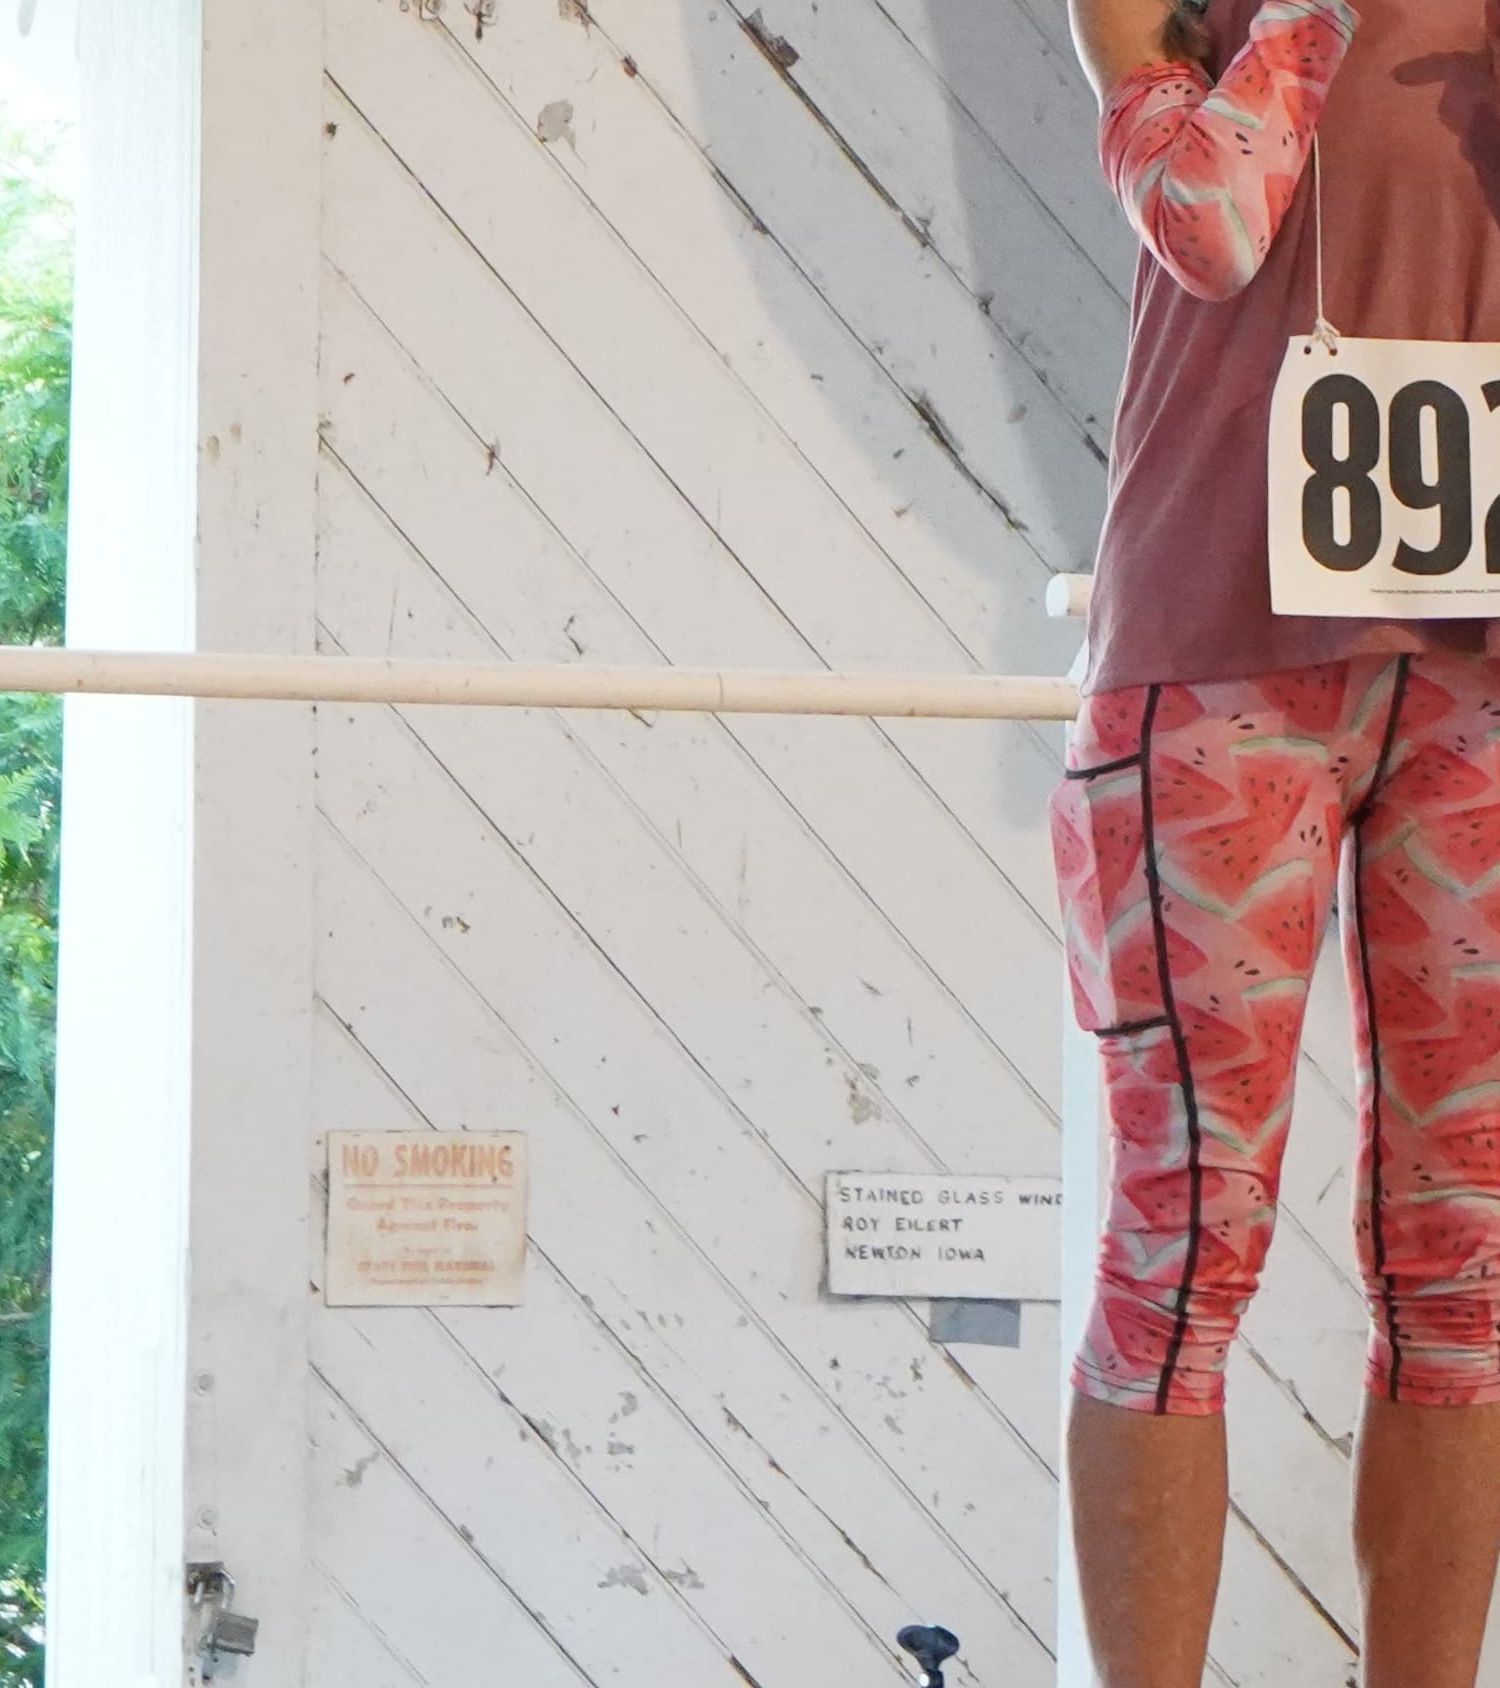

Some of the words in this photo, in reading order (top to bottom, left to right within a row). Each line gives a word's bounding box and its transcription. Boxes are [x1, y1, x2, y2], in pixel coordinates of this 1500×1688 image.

[341, 1143, 380, 1178] NO
[393, 1143, 515, 1178] SMOKING
[839, 1186, 924, 1206] STAINED
[937, 1190, 1005, 1206] GLASS
[841, 1216, 880, 1232] ROY
[894, 1216, 964, 1232] EILERT
[844, 1245, 921, 1260] NEWTON
[937, 1247, 986, 1261] IOWA
